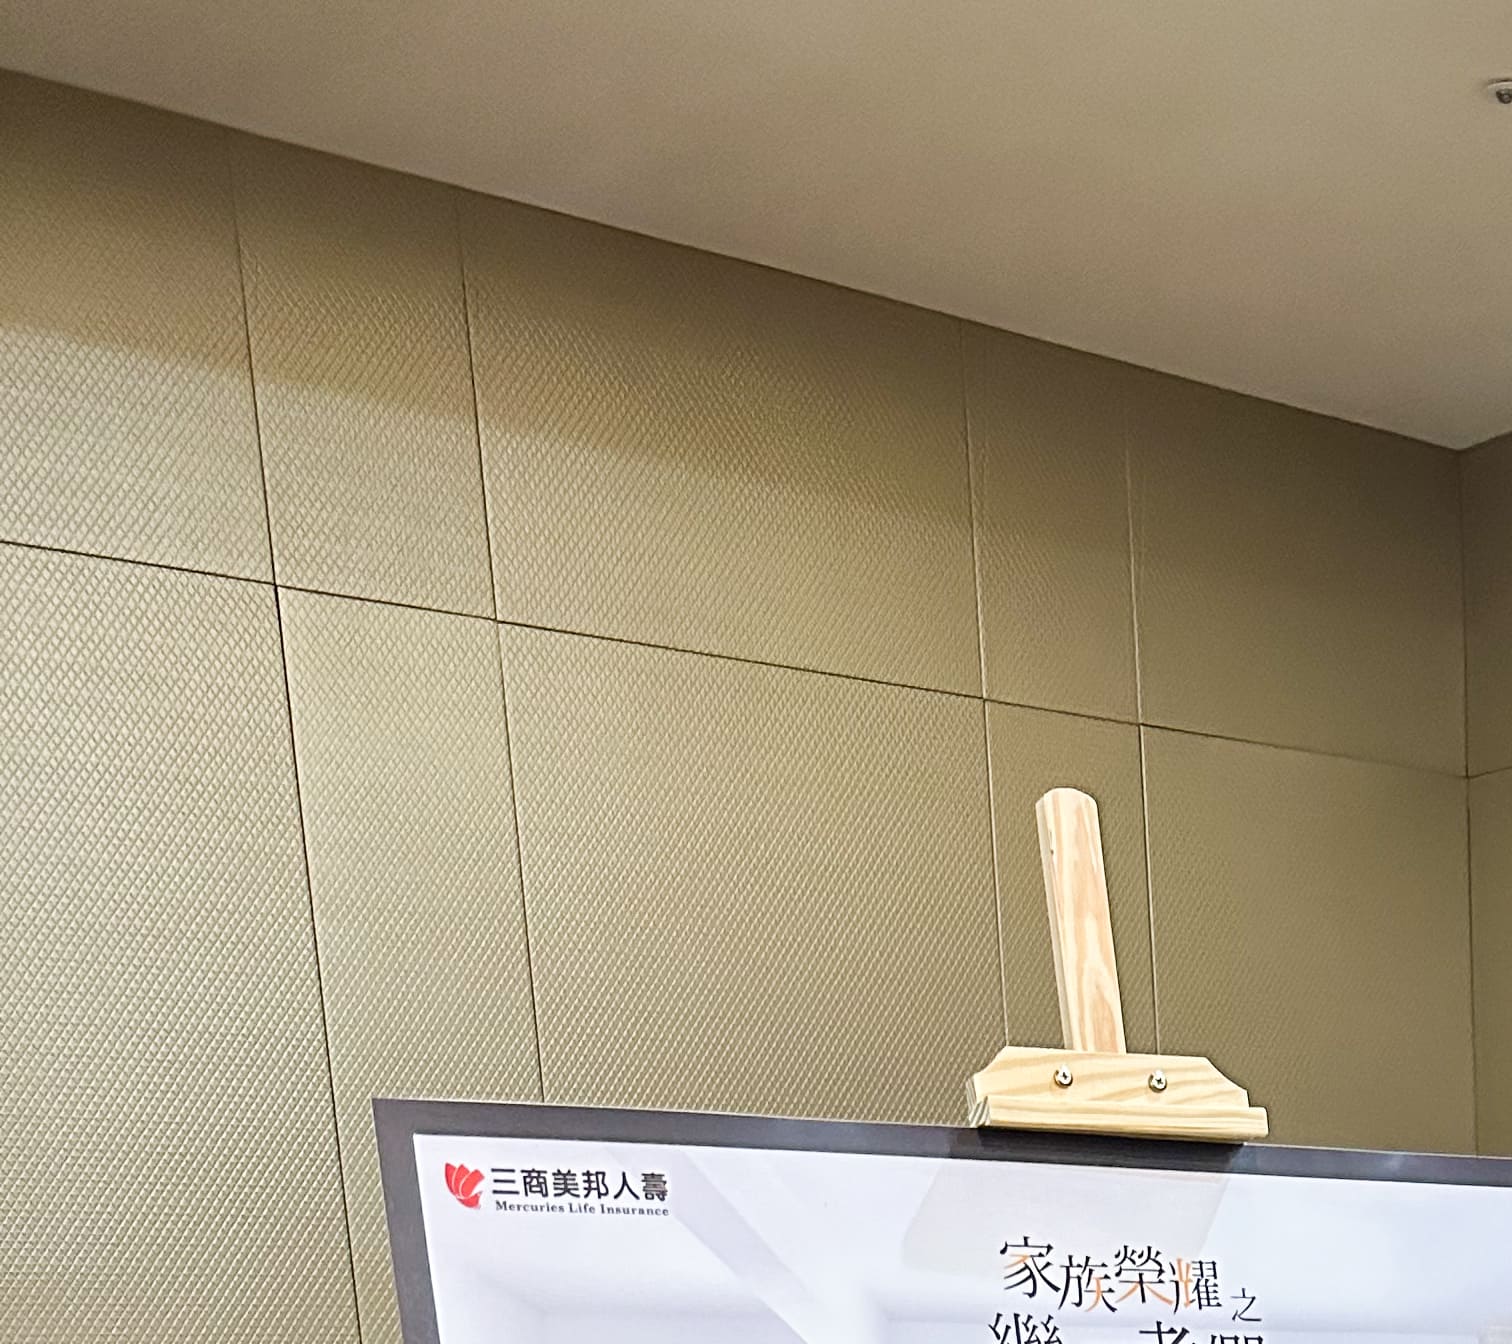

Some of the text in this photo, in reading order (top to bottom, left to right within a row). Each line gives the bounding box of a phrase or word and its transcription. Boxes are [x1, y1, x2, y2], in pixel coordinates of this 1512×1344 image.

[490, 1167, 669, 1202] 三商美邦人壽
[496, 1200, 670, 1217] Mercuries Life Insurance
